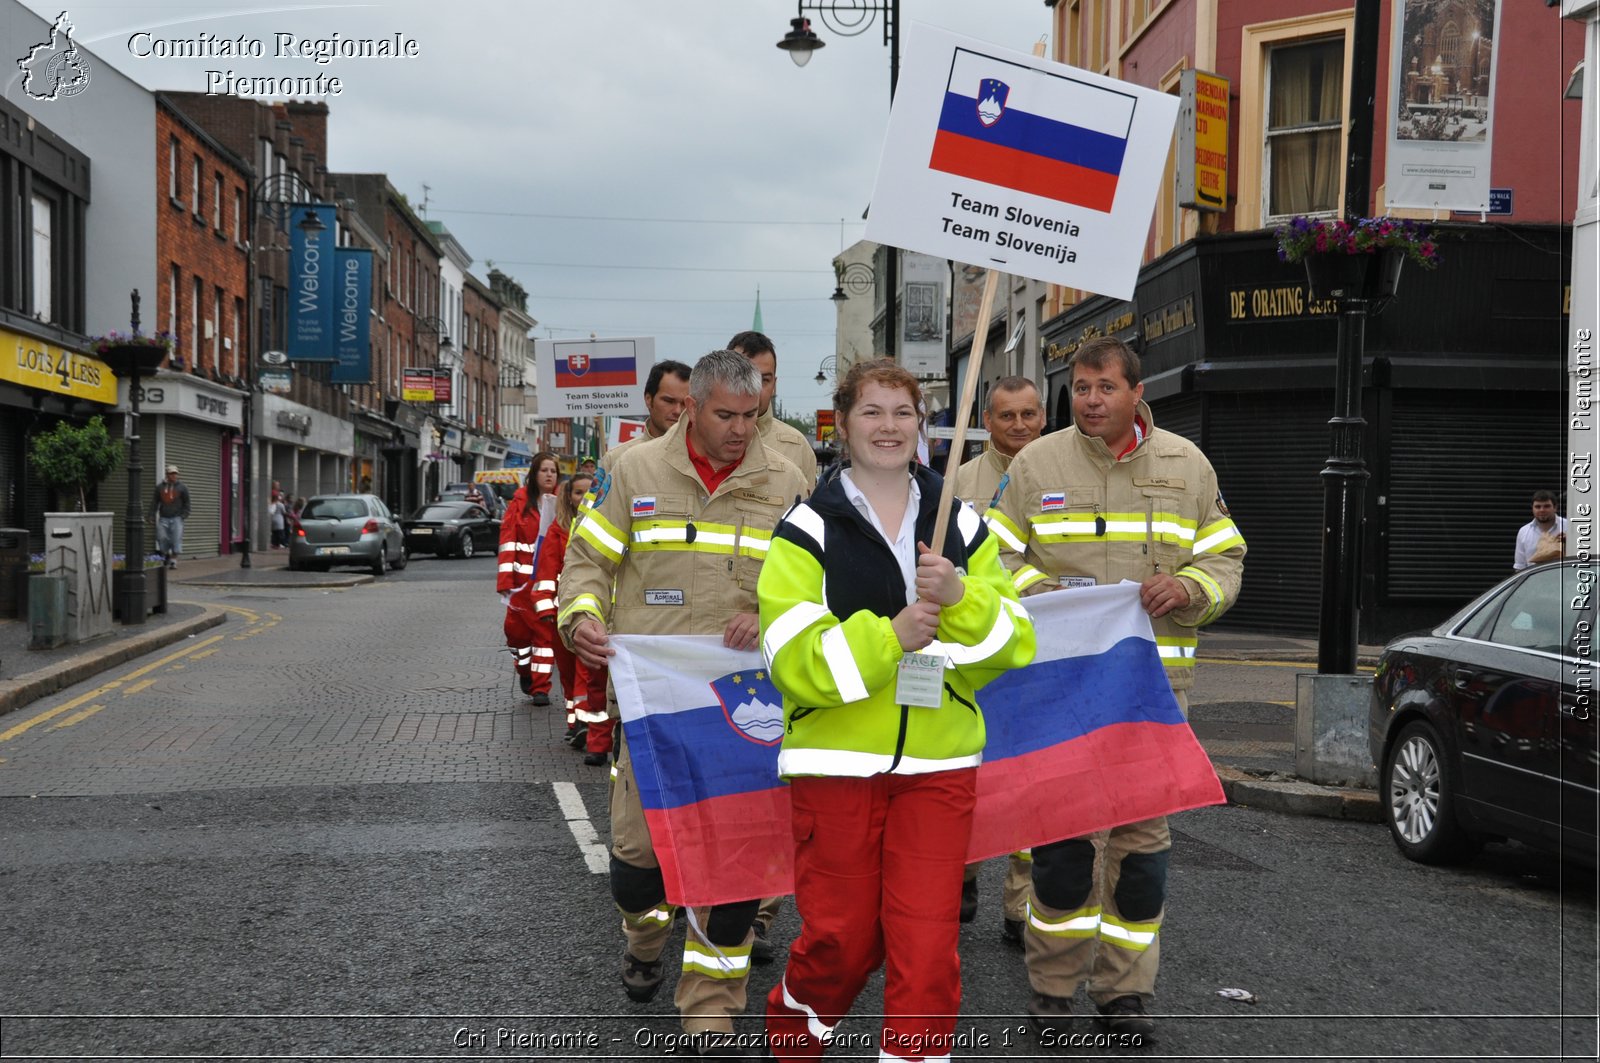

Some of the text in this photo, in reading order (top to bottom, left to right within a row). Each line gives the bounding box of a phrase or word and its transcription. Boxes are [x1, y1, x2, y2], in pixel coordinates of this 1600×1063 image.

[1196, 116, 1208, 135] LTD
[951, 192, 1080, 237] Team Slovenia
[941, 217, 1078, 263] Team Slovenija
[341, 258, 360, 342] Welcome
[585, 401, 629, 409] Slovensko
[592, 391, 629, 399] Slovakia
